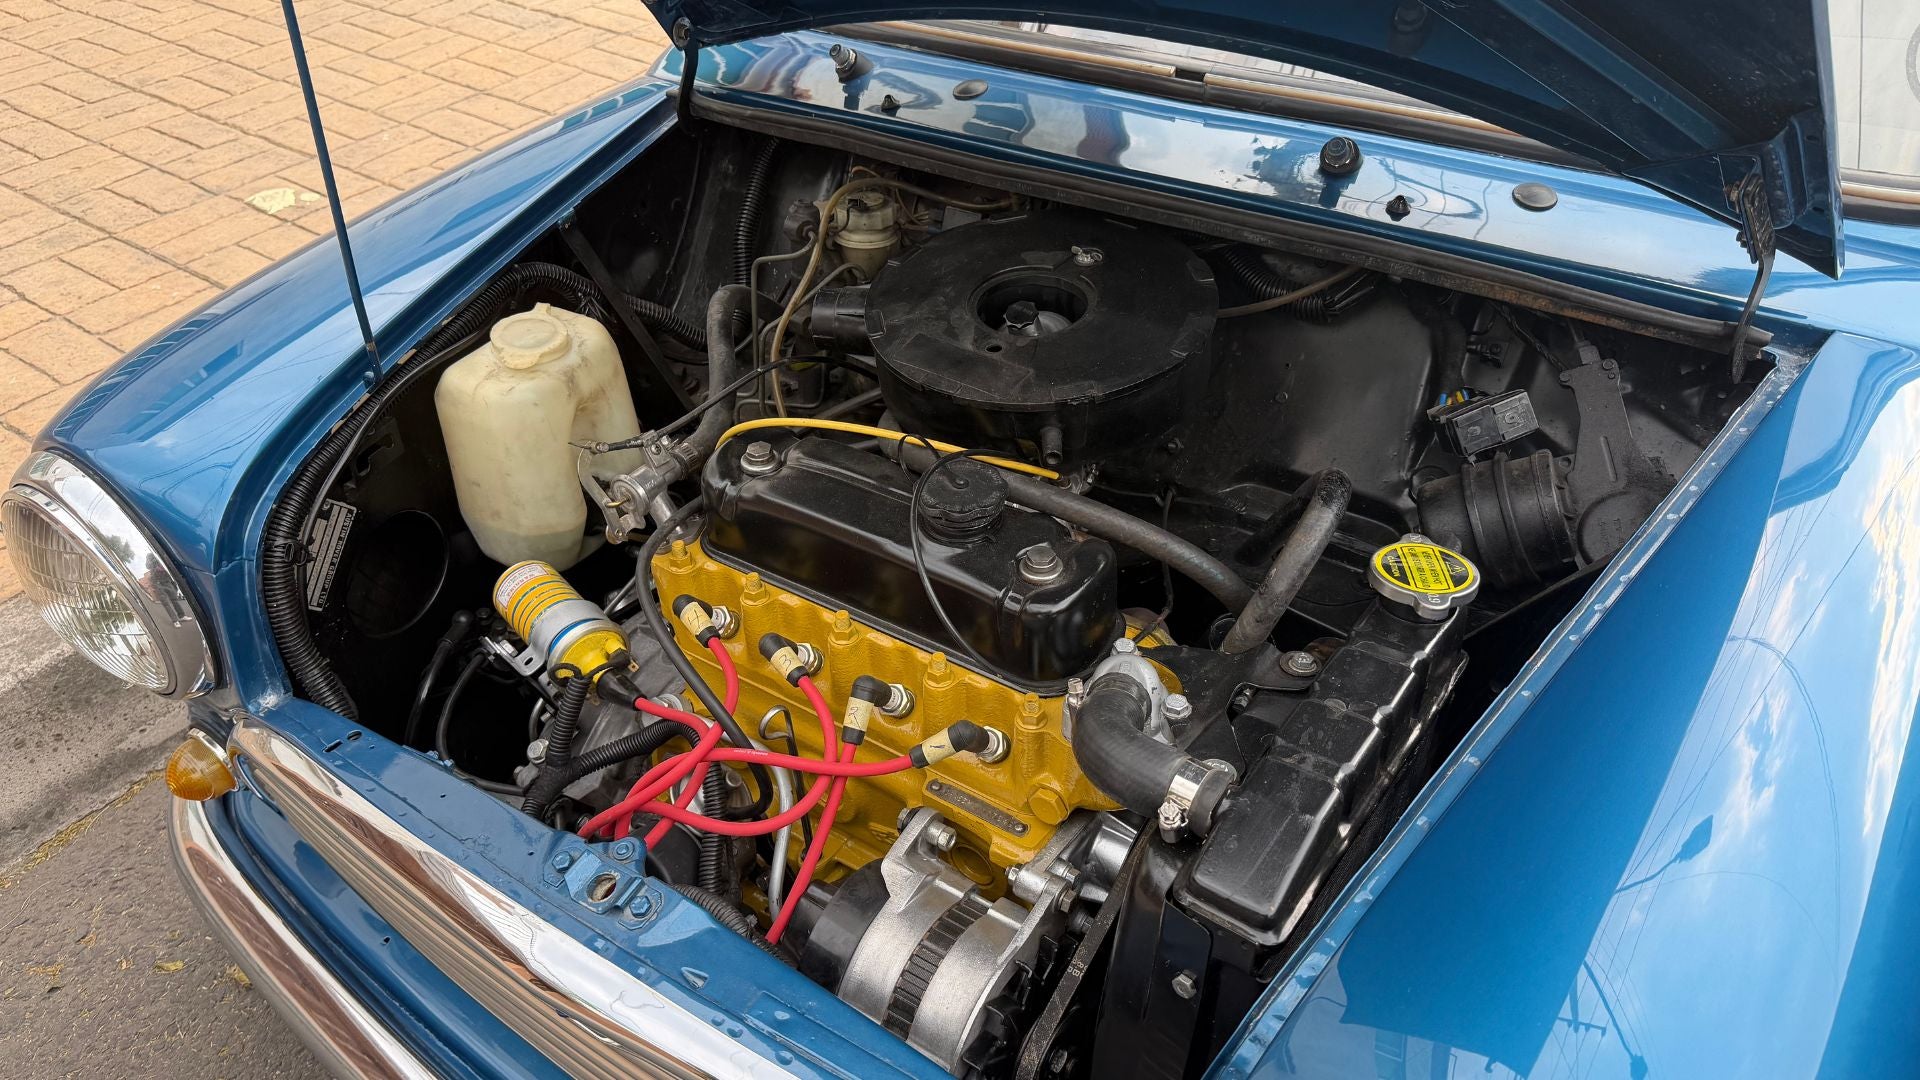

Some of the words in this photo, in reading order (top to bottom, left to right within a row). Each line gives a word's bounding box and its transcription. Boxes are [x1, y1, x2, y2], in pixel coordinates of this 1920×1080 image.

[340, 513, 351, 538] AUSTIN
[332, 540, 342, 563] ROVER
[324, 565, 334, 588] GROUP
[1387, 555, 1400, 577] CAUTION
